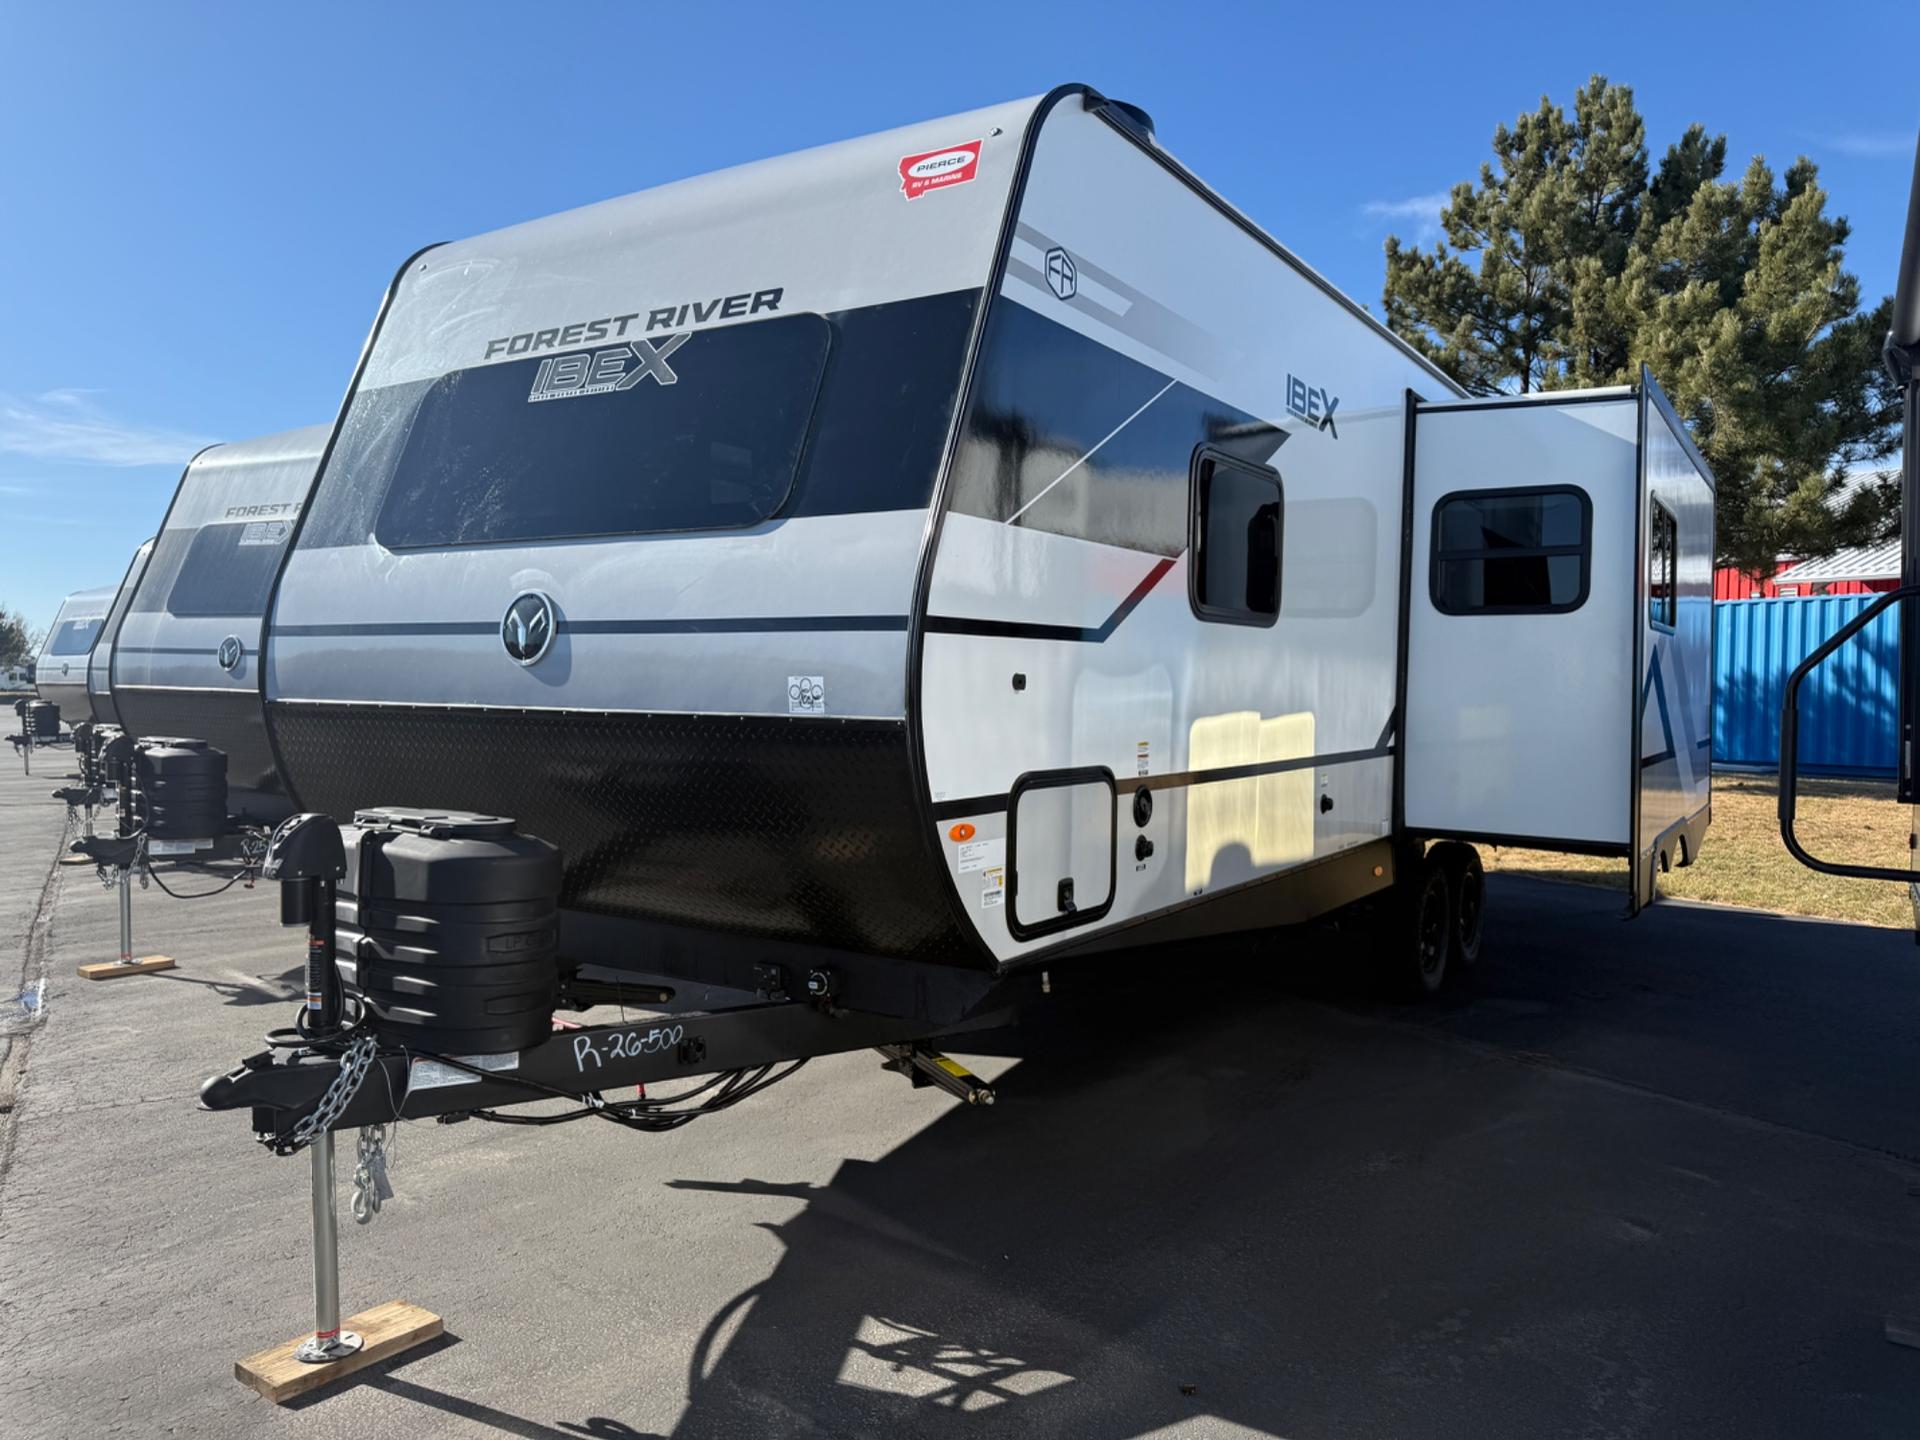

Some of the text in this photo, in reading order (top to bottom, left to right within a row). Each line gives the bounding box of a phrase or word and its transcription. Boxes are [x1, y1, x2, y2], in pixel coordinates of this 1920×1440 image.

[912, 180, 923, 189] RV
[931, 172, 963, 185] MARINE
[916, 155, 966, 173] PIERCE
[483, 287, 784, 361] FOREST RIVER
[529, 331, 692, 397] IBEX
[1286, 373, 1340, 440] IBEX
[225, 503, 292, 518] FOREST
[573, 1024, 683, 1073] R-26-500
